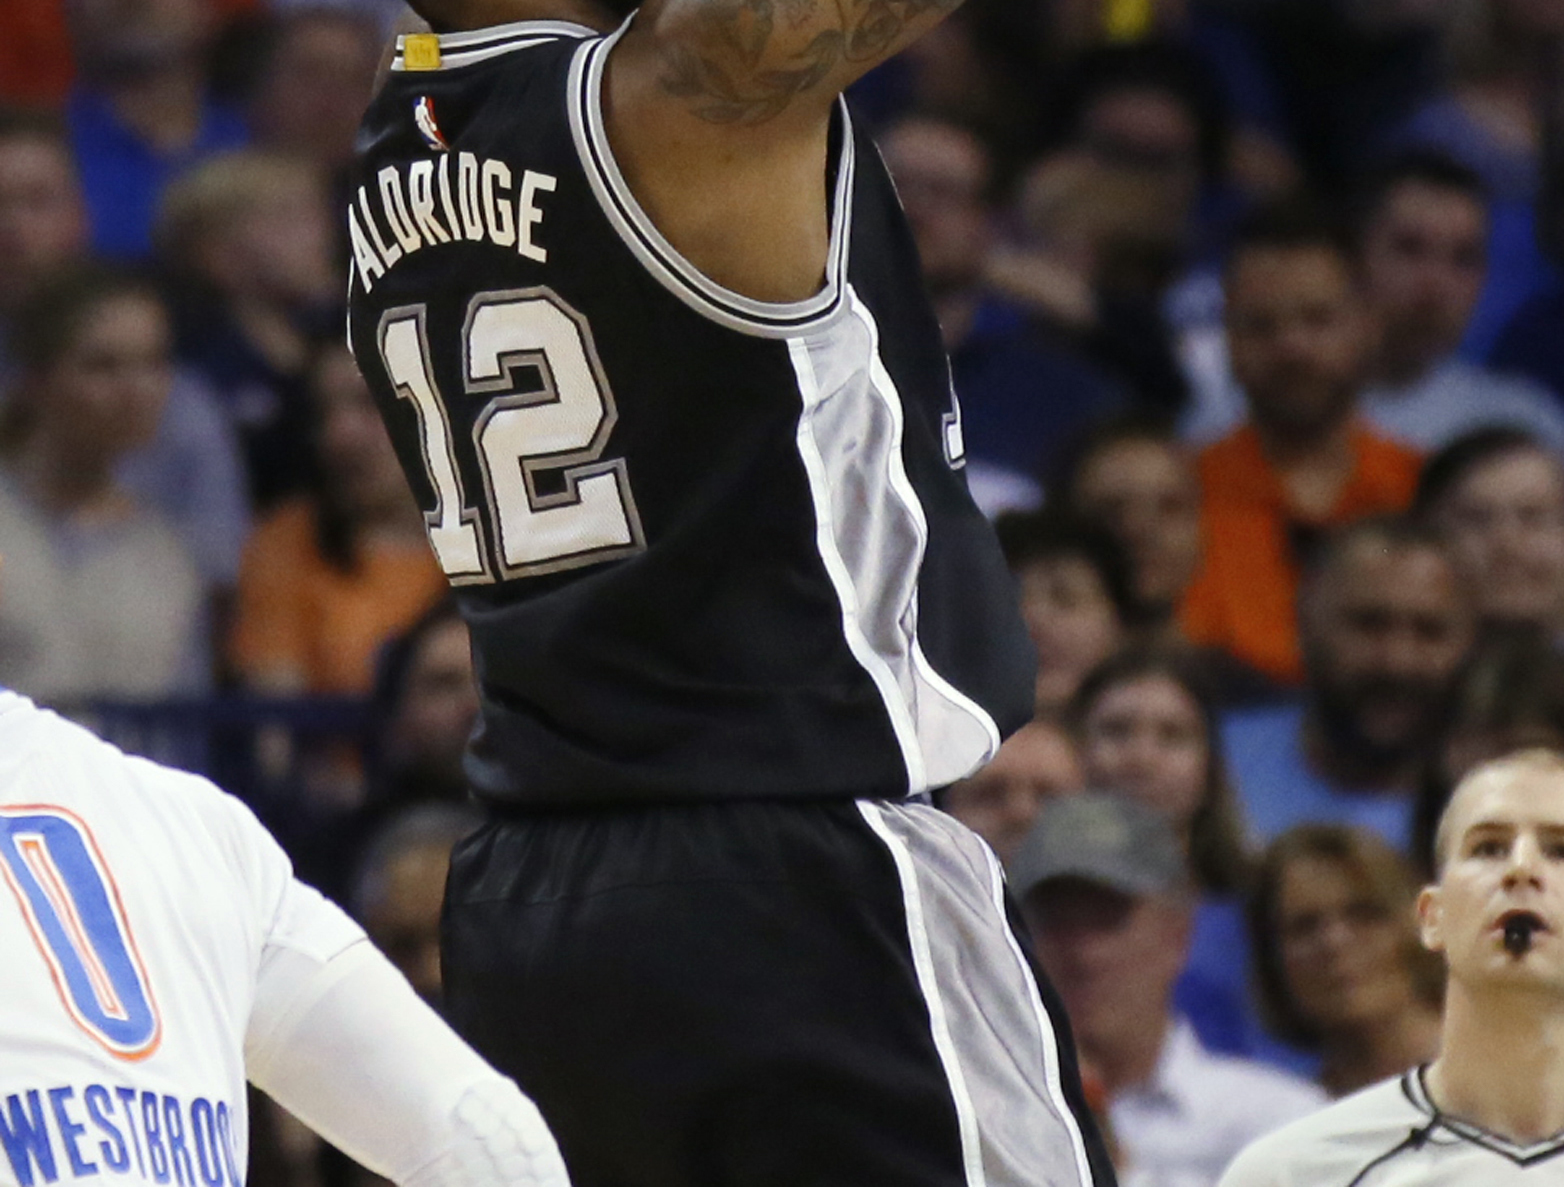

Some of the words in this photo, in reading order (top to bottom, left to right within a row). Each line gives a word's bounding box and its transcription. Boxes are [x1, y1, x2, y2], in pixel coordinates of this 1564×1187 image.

[348, 151, 557, 292] ALDRIDGE
[377, 285, 648, 587] 12
[0, 803, 162, 1061] 0
